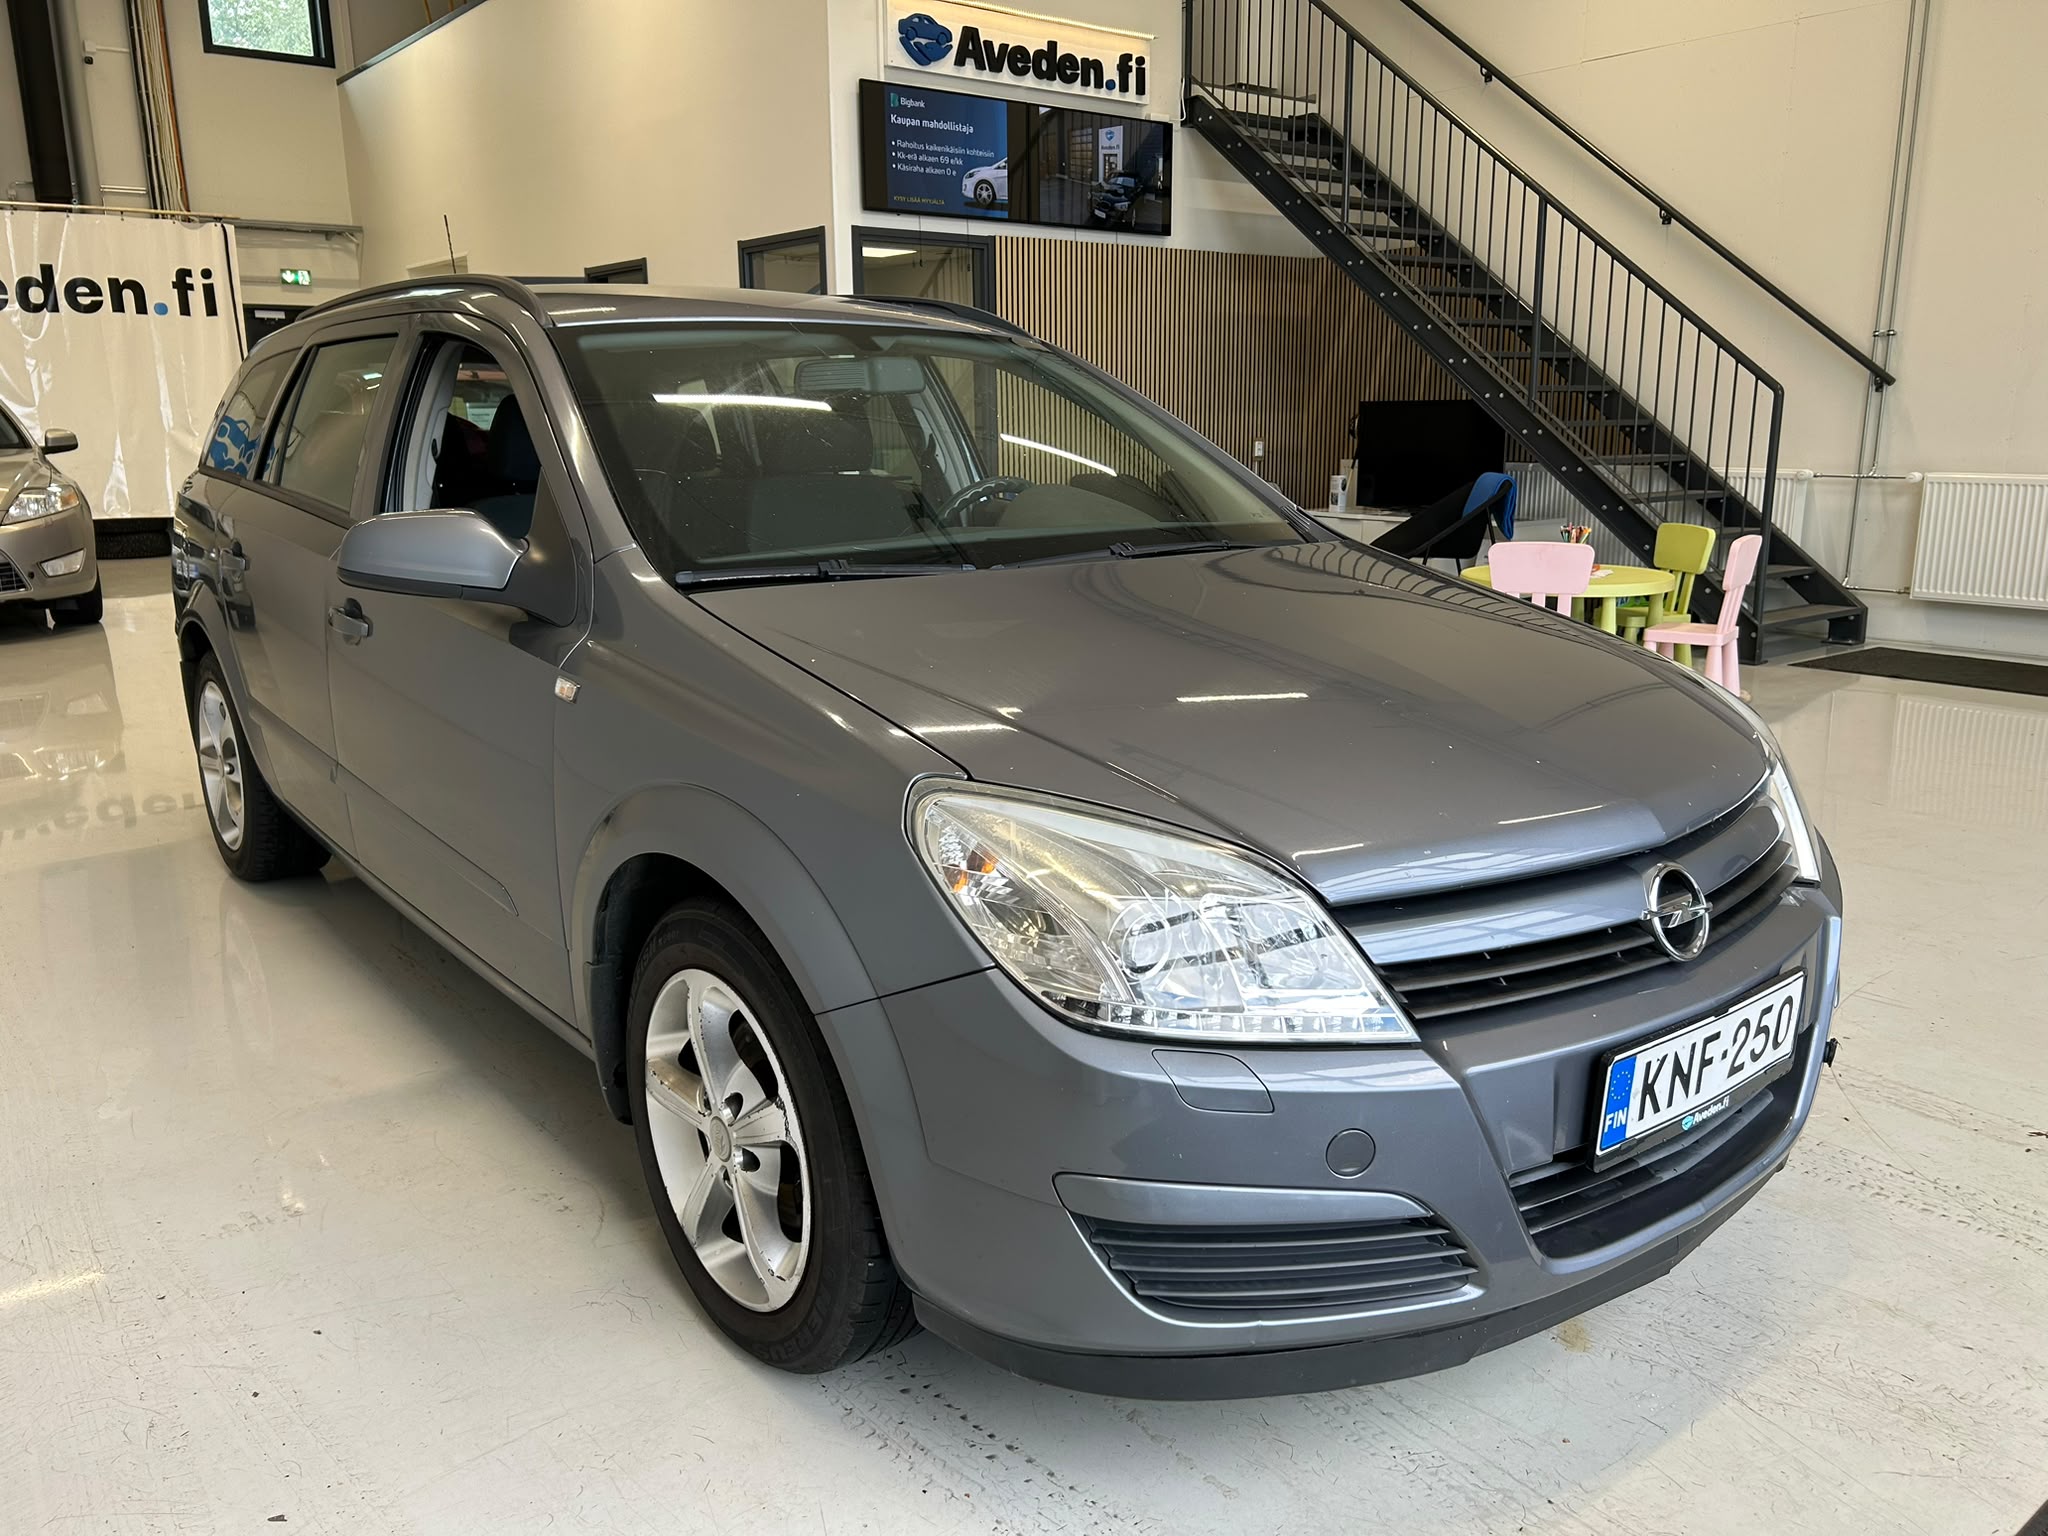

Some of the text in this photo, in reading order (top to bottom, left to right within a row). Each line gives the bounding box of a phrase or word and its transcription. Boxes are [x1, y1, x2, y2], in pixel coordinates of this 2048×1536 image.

[953, 25, 1146, 96] Aveden.fi
[900, 97, 926, 108] Bigbank
[890, 113, 974, 135] Kaupan mahdollistaja
[896, 139, 924, 150] Rahoitus
[897, 163, 924, 173] Käsiraha
[925, 166, 945, 175] alkaen
[918, 154, 939, 163] alkaen
[940, 155, 949, 165] 69
[0, 263, 219, 317] den.fi
[1637, 995, 1794, 1122] KNF-250
[1603, 1107, 1628, 1133] FIN
